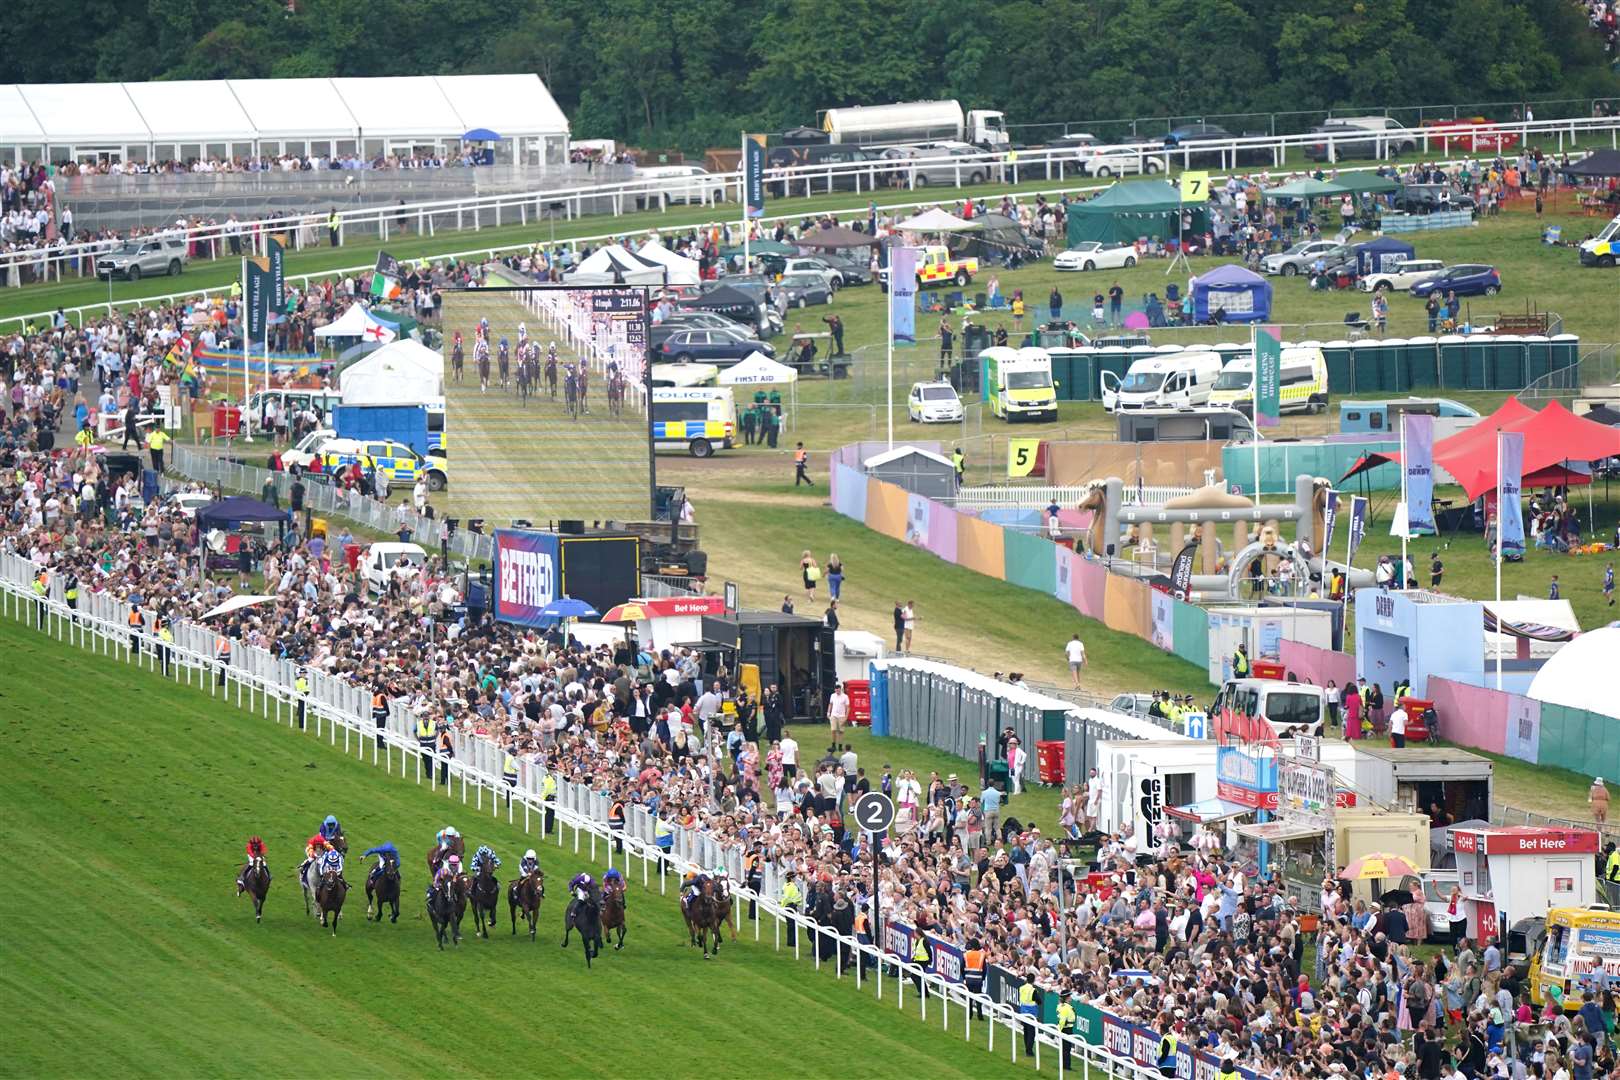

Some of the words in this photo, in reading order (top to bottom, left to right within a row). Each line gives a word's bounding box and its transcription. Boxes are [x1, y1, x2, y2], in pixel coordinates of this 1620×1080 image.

[1190, 180, 1200, 194] 7
[1016, 448, 1028, 466] 5
[501, 548, 553, 608] BETFRED
[1376, 596, 1394, 618] DERBY
[867, 802, 882, 823] 2
[1152, 779, 1161, 847] GENS
[1458, 836, 1473, 849] tote
[1520, 838, 1536, 849] Bet
[1540, 838, 1566, 848] Here
[886, 926, 907, 957] BETFRED
[937, 948, 960, 980] BETFRED
[1574, 960, 1592, 974] MIND
[1103, 1022, 1130, 1054] BETFRED
[1134, 1034, 1158, 1067] BETFRE
[1176, 1050, 1192, 1080] FRED
[1196, 1058, 1216, 1080] BETFR
